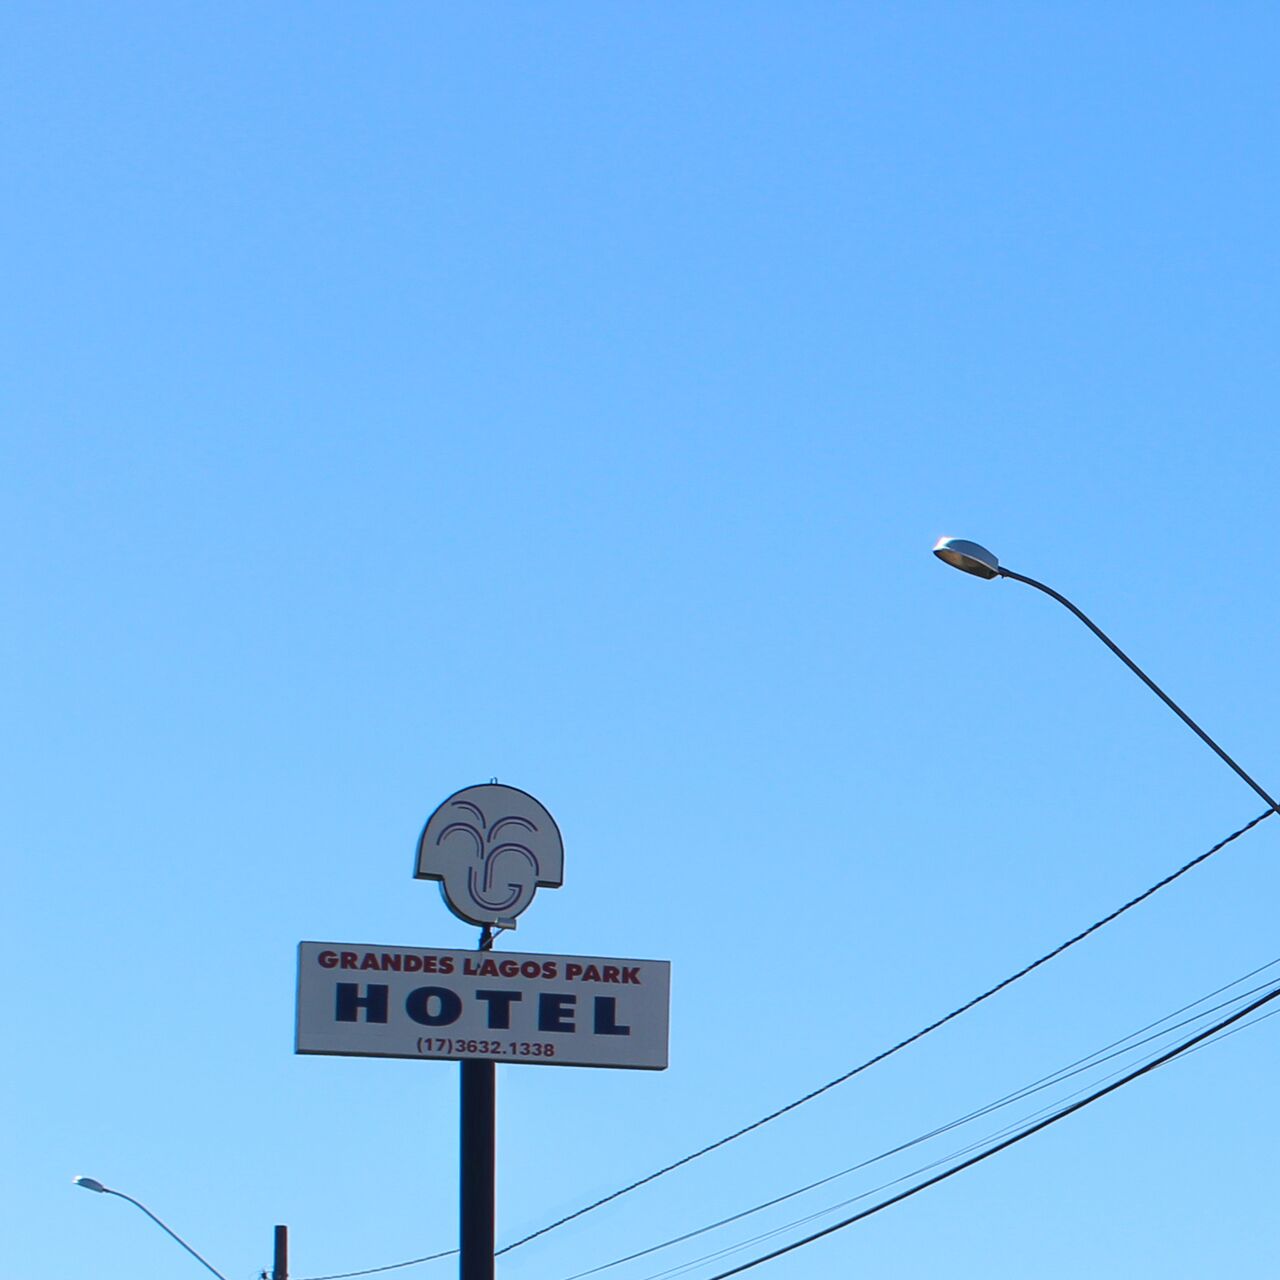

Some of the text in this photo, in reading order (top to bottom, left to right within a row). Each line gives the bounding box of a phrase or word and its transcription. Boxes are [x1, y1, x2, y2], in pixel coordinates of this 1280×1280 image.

[318, 951, 641, 985] GRANDES LAGOS PARK
[335, 983, 631, 1036] HOTEL
[416, 1037, 555, 1057] (17)3632.1338
